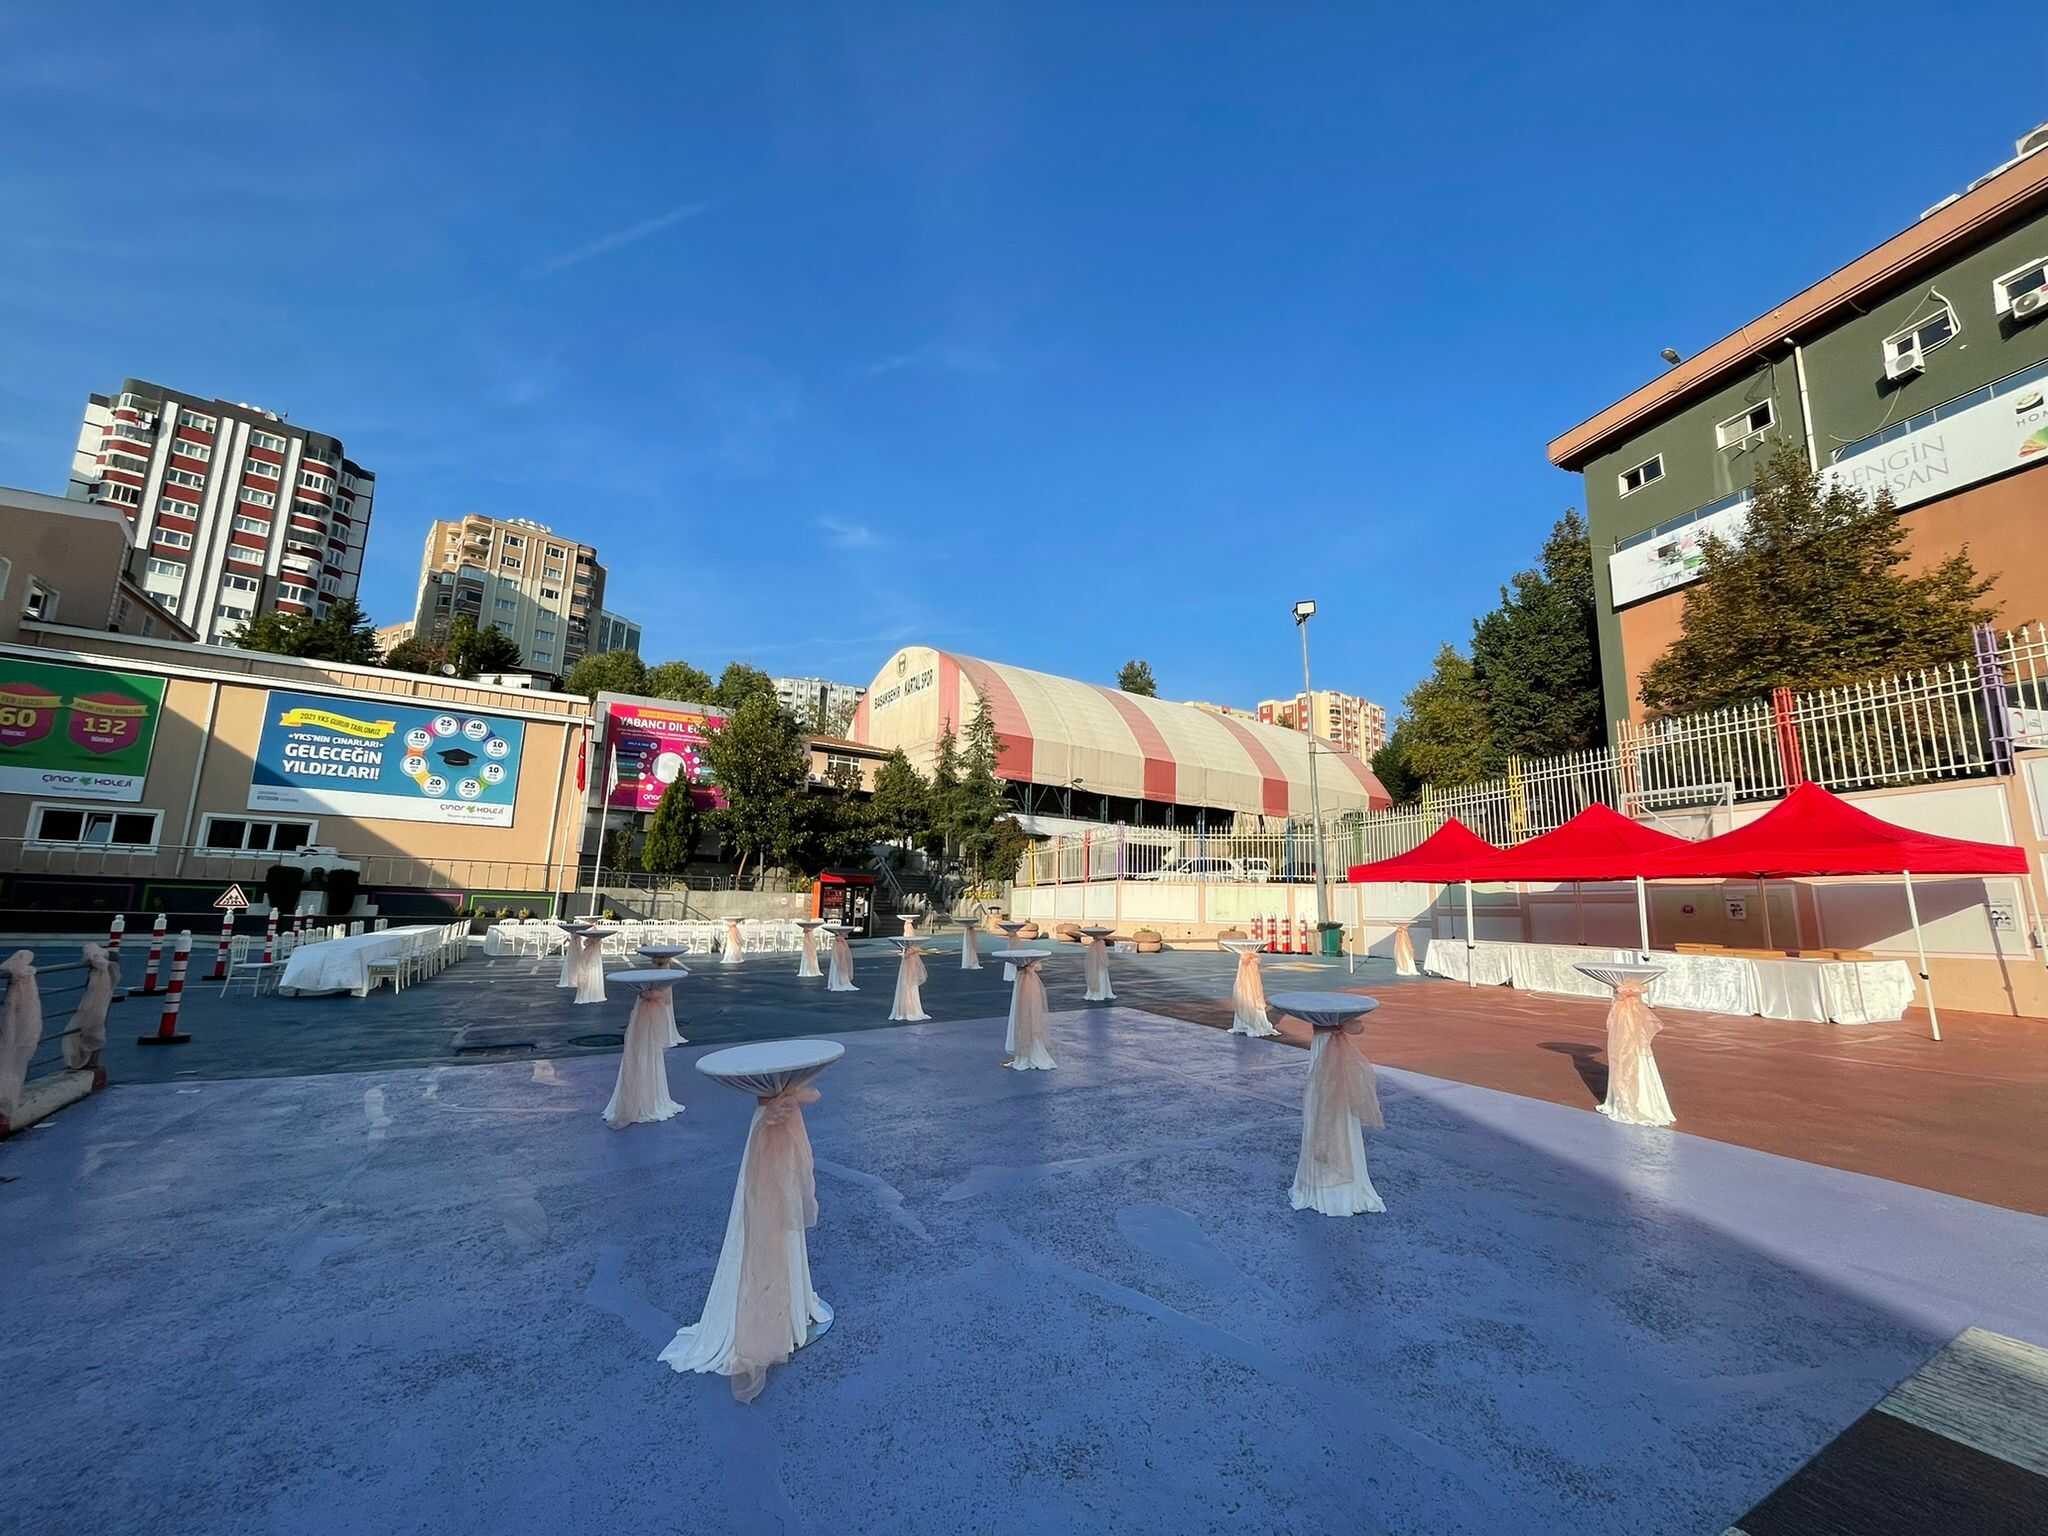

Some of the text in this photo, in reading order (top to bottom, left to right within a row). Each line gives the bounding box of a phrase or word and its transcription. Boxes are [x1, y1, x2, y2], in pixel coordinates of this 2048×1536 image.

[300, 712, 316, 720] 2021
[317, 715, 330, 723] YKS
[440, 719, 452, 727] 25
[619, 716, 666, 730] YABANCI
[83, 717, 127, 735] 132
[284, 743, 383, 764] GELECEĞİN
[409, 758, 421, 766] 23
[282, 759, 380, 780] YILDIZLARI!
[430, 778, 441, 786] 20
[464, 781, 476, 789] 25
